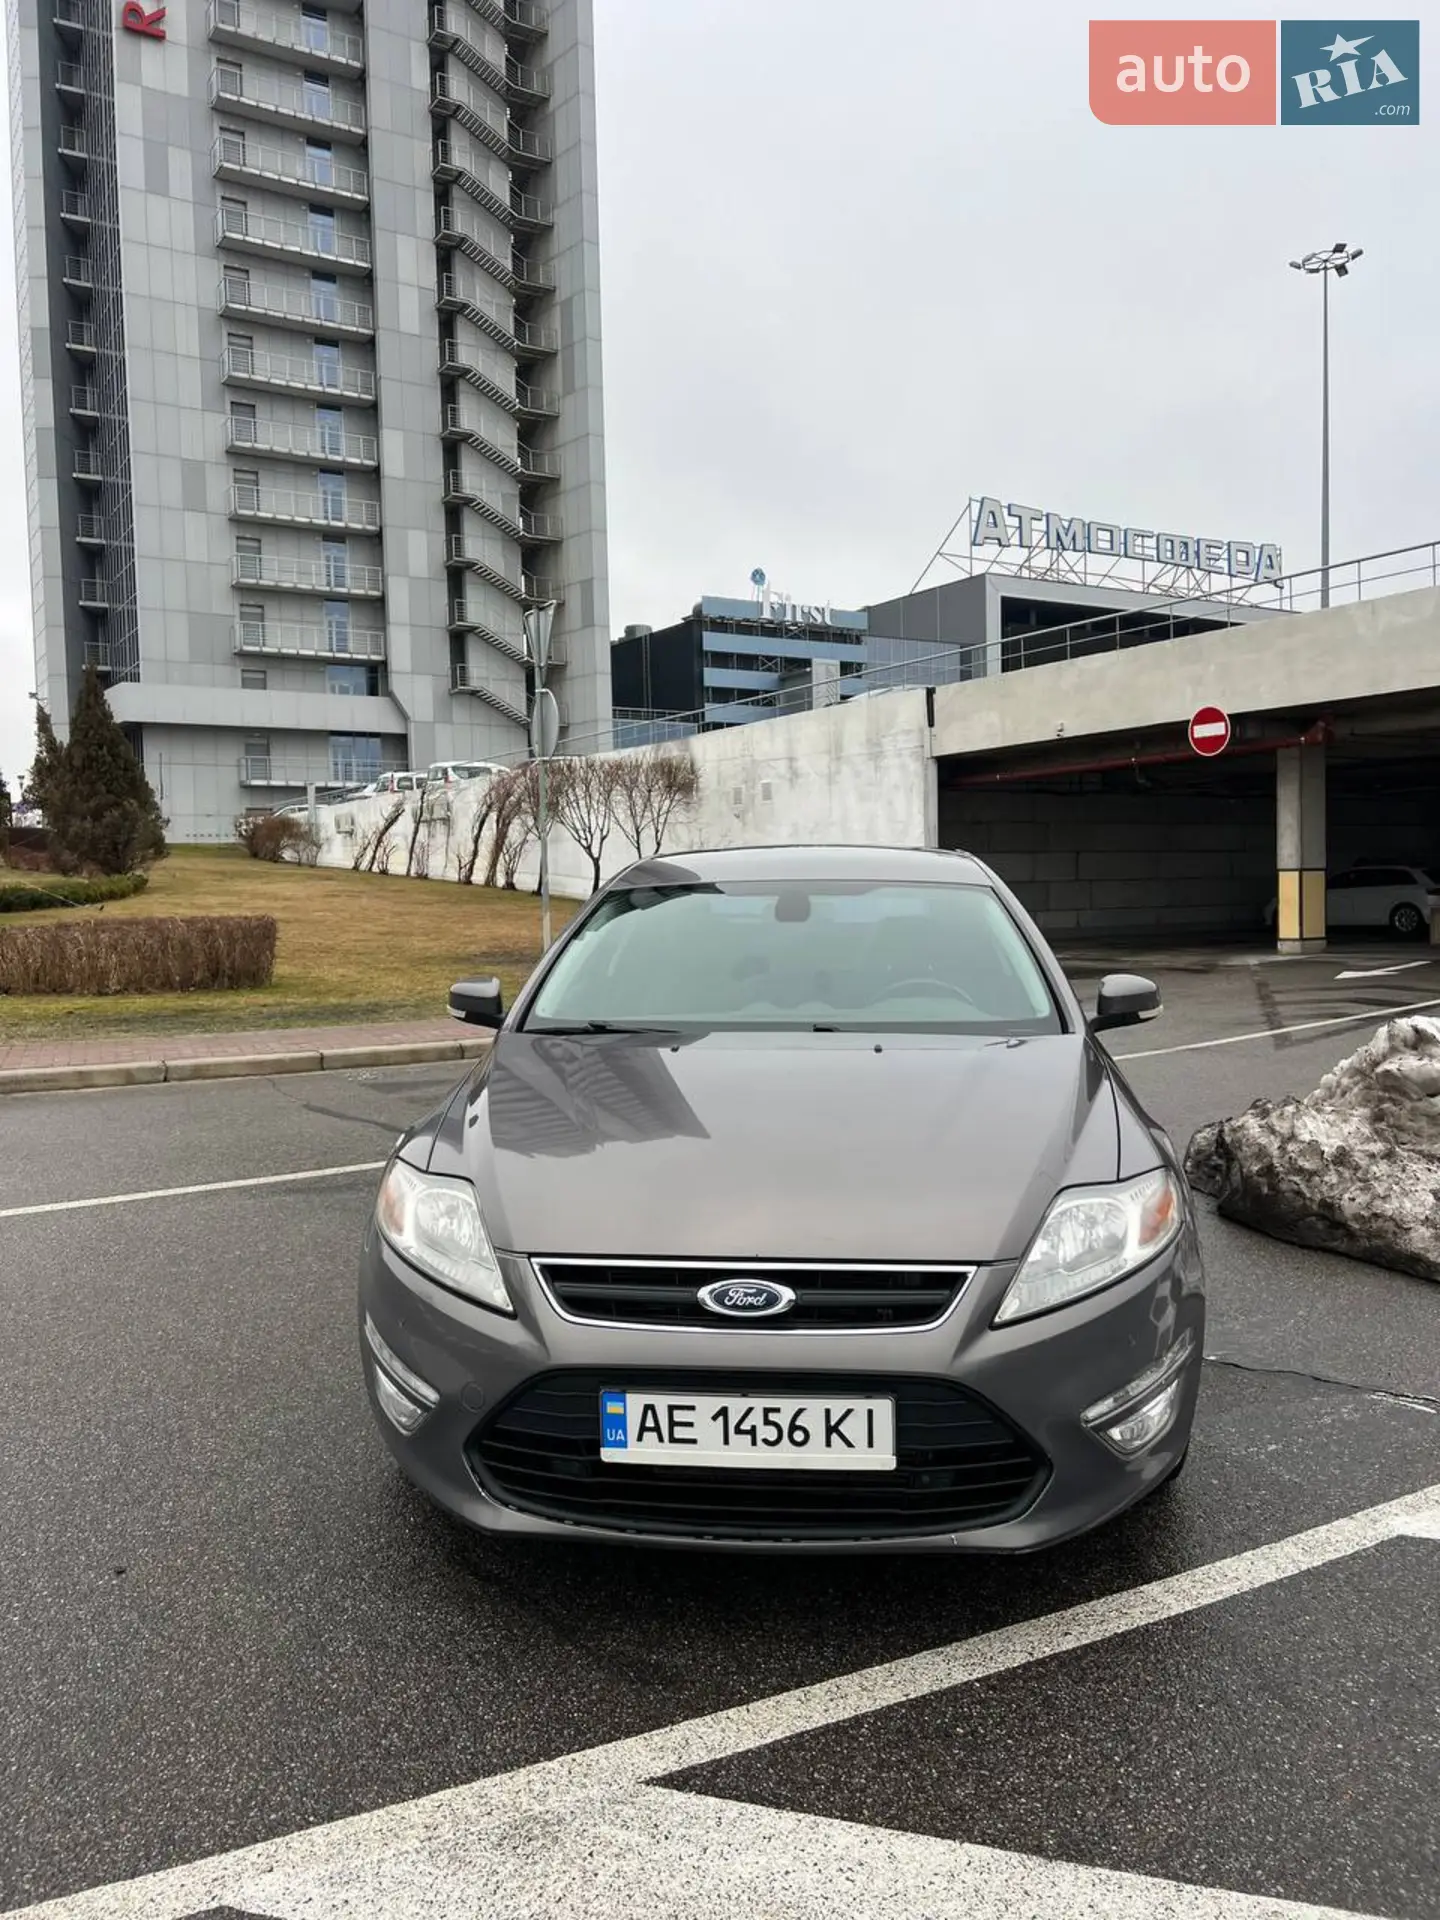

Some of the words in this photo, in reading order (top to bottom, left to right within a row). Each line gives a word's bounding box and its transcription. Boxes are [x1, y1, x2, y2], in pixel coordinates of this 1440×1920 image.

[973, 496, 1284, 589] АТМОСФЕРА
[761, 588, 832, 626] First
[724, 1288, 768, 1306] Ford
[606, 1429, 625, 1441] UA
[636, 1404, 698, 1444] AE
[711, 1405, 811, 1447] 1456
[824, 1408, 874, 1449] KI
